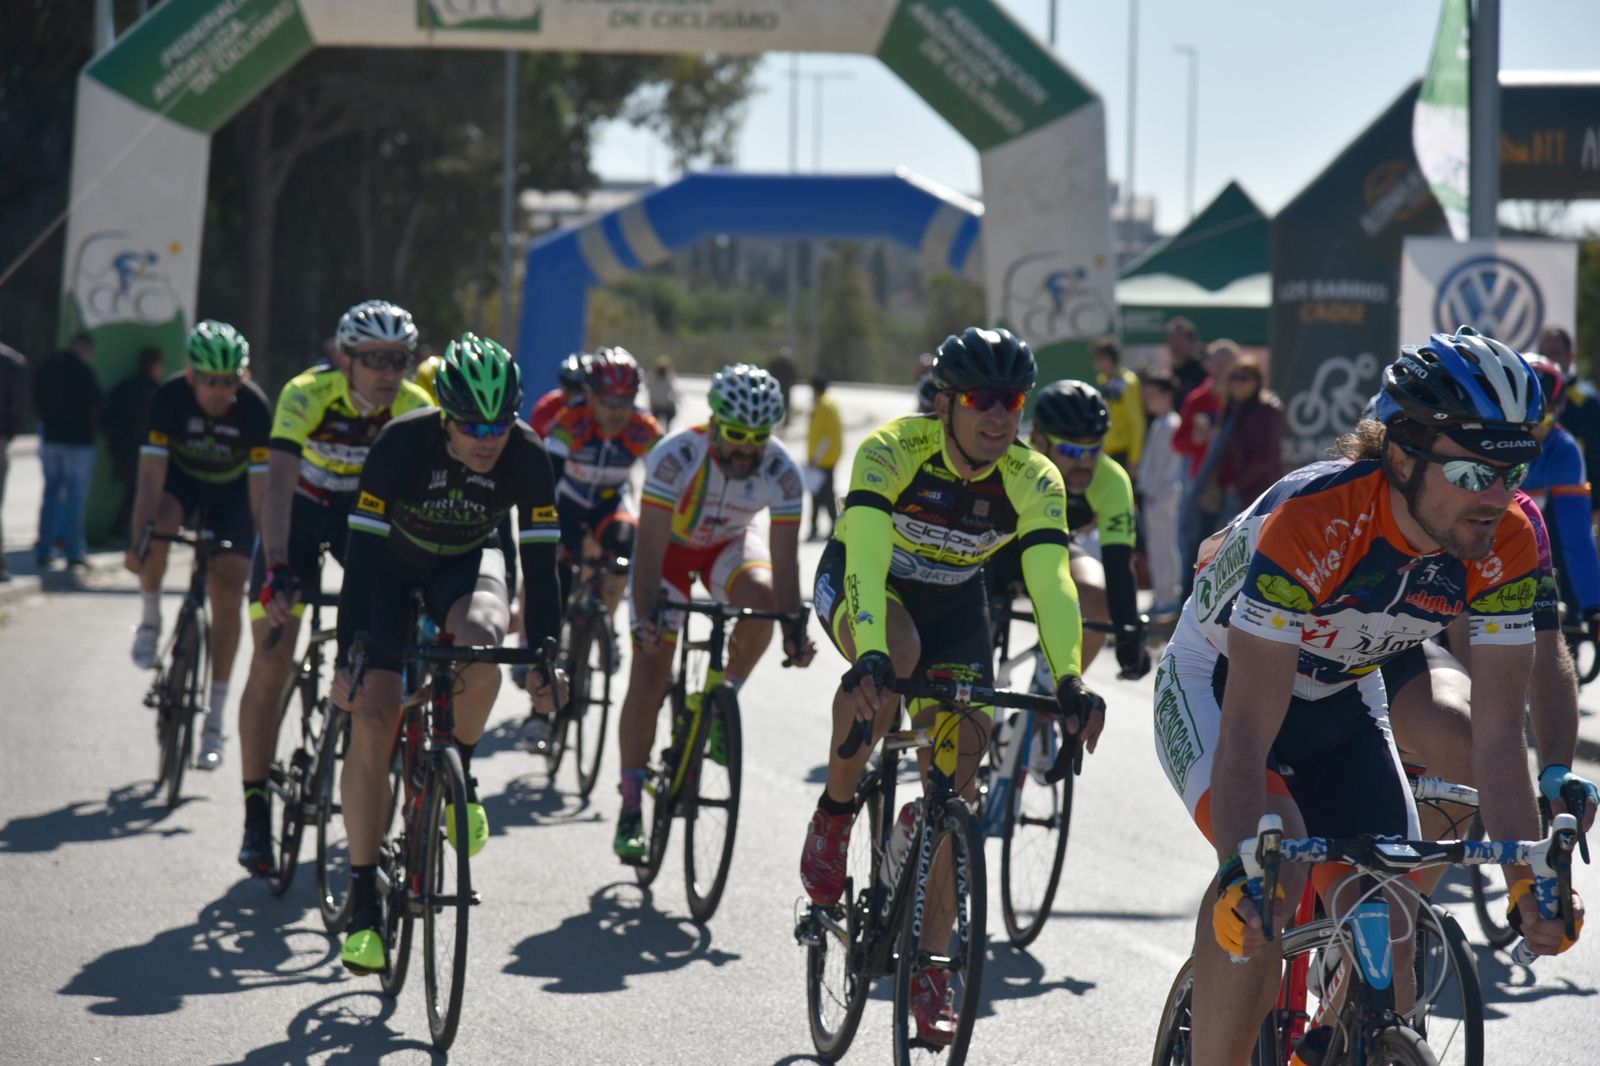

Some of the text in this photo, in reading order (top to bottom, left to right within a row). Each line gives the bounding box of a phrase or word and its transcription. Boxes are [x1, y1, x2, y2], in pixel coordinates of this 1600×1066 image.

[608, 9, 780, 31] DE CICLISMO
[1500, 438, 1537, 450] GIANT
[422, 498, 486, 513] GRUPO
[912, 824, 934, 937] COLNAGO
